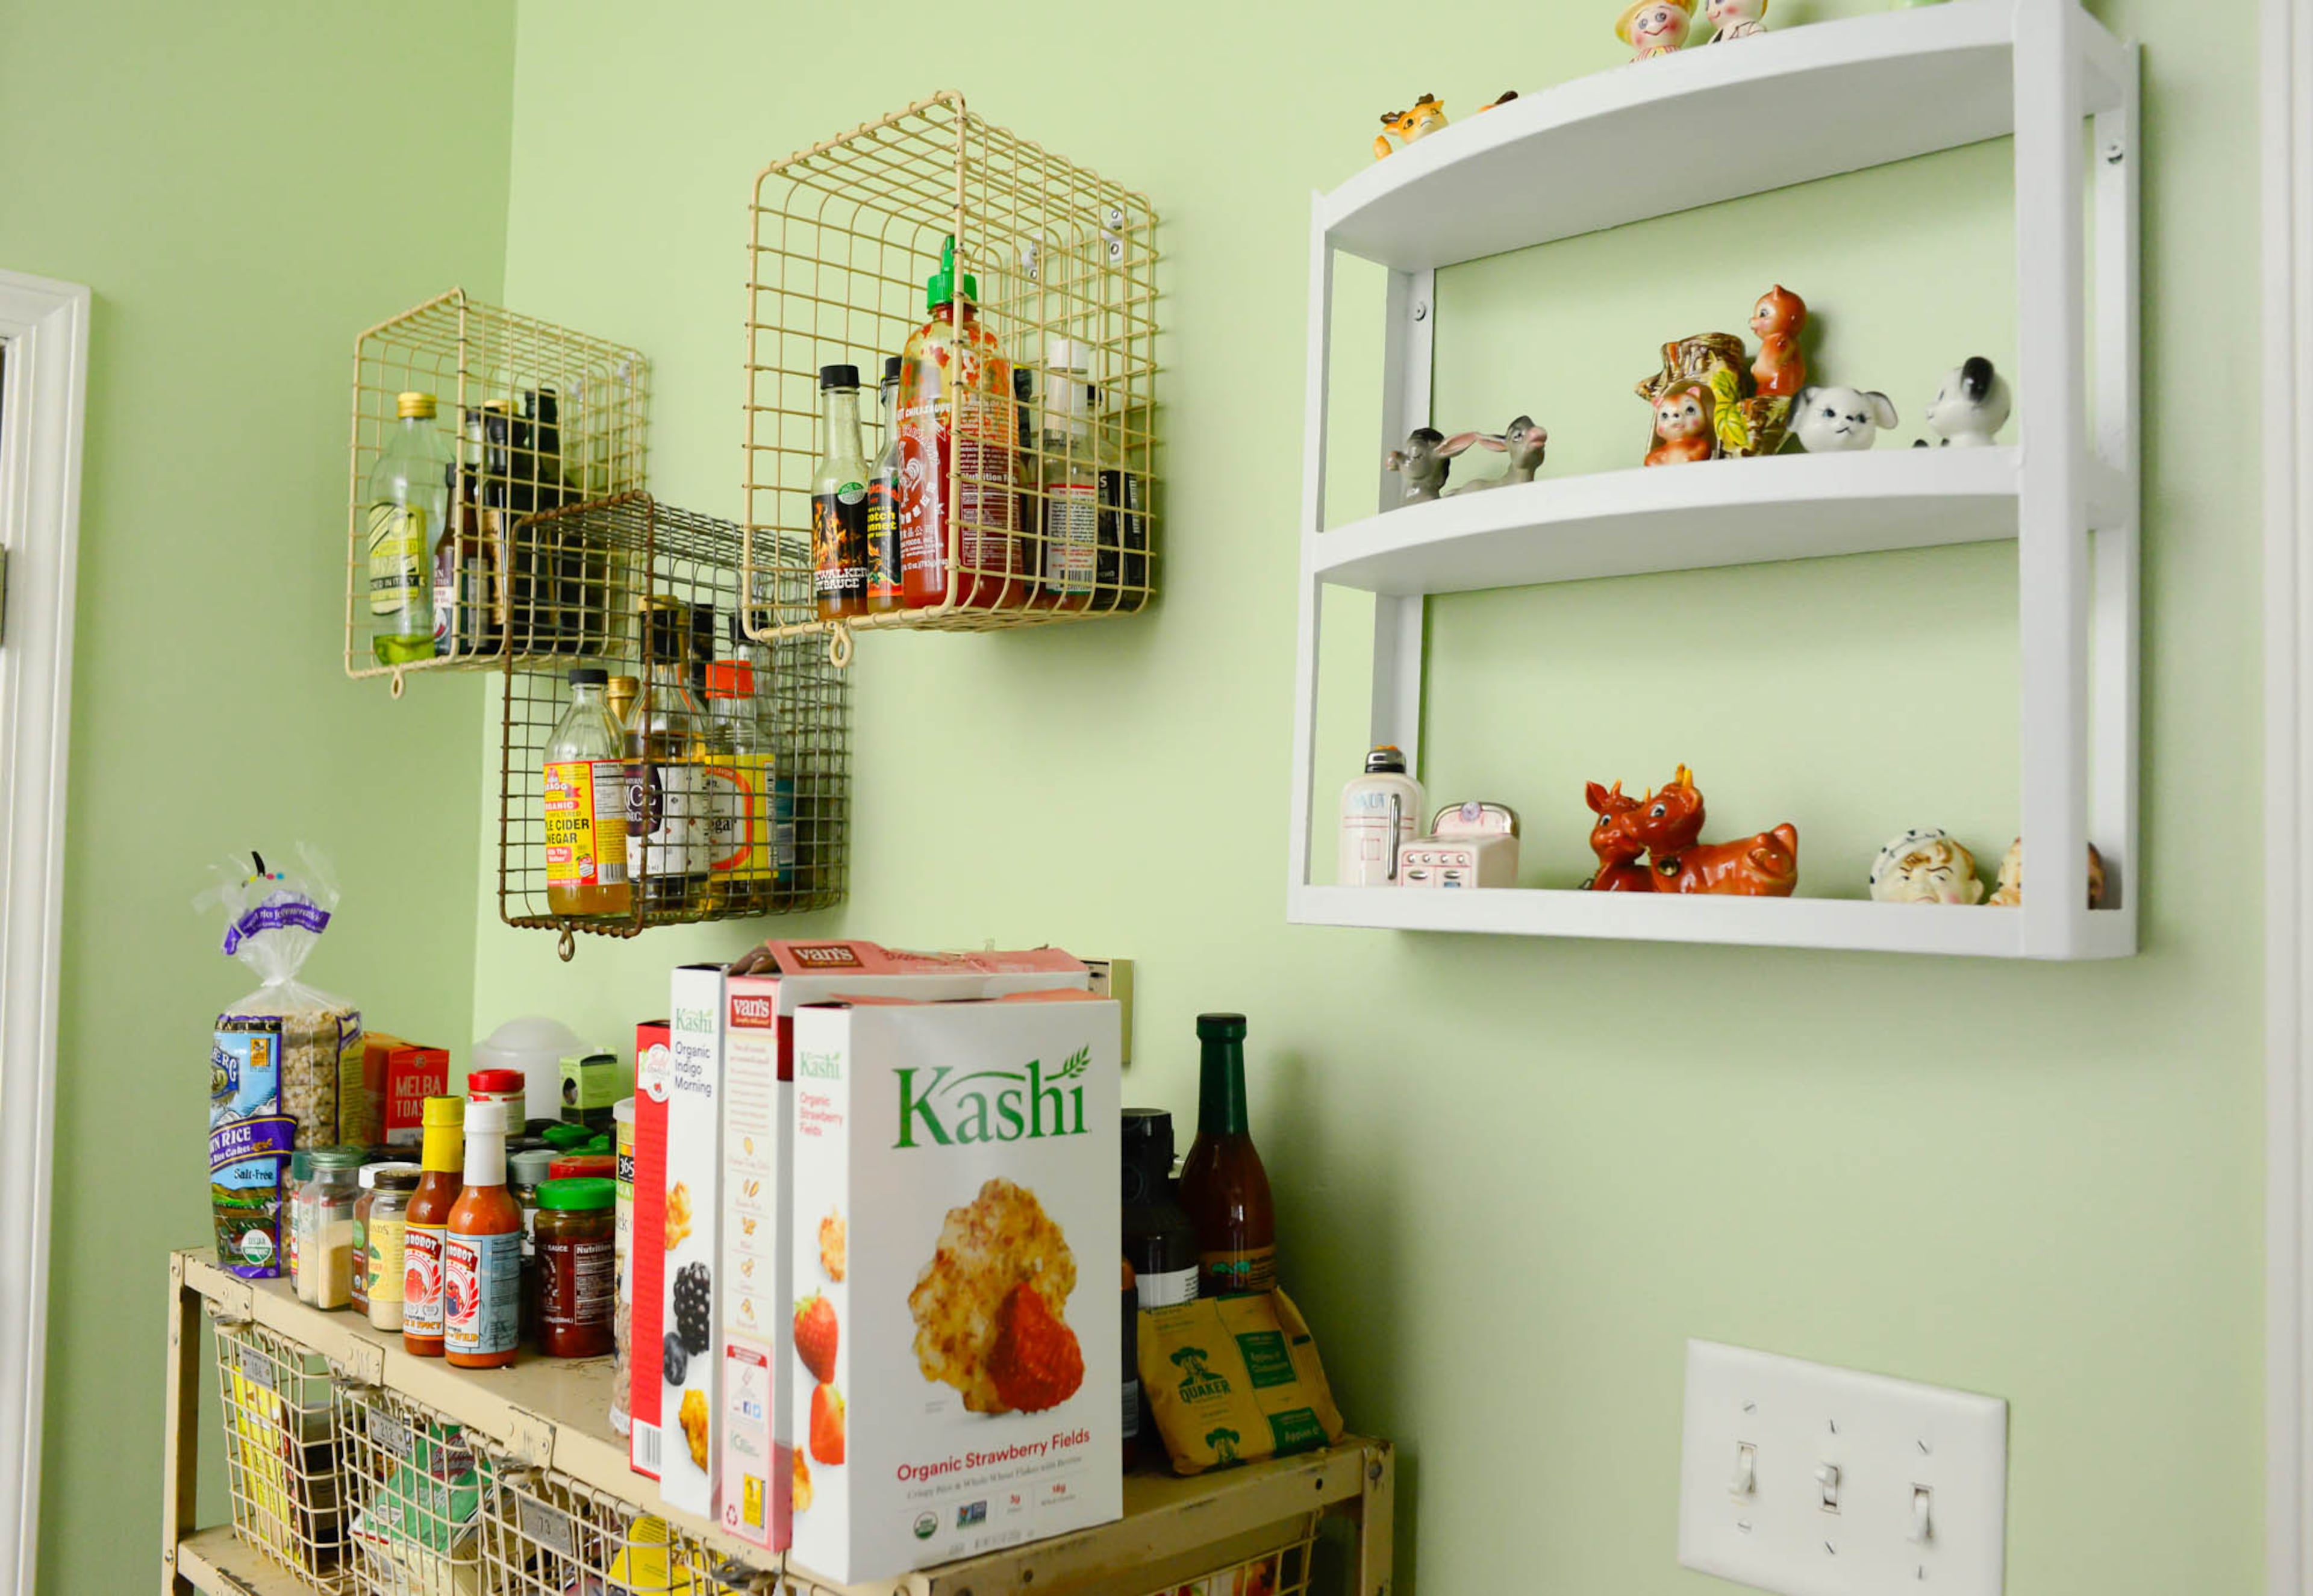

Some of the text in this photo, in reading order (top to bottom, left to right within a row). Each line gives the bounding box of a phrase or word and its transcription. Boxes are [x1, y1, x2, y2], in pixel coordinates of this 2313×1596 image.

[963, 472, 1002, 481] Nutition
[556, 818, 590, 831] CIDER
[795, 947, 854, 961] van's
[733, 999, 770, 1018] van's
[676, 1008, 714, 1034] Kashi
[675, 1041, 710, 1059] Organic
[675, 1059, 702, 1076] Indigo
[799, 1052, 842, 1080] Kashi
[395, 1074, 442, 1098] MELBA
[674, 1076, 712, 1097] Morning
[799, 1091, 831, 1108] Organic
[891, 1048, 1091, 1149] Kashi
[396, 1100, 424, 1118] TOAS
[799, 1107, 843, 1126] Strawberry
[221, 1126, 251, 1147] RICE
[799, 1123, 823, 1137] Fields
[234, 1168, 273, 1180] Salt-Free
[619, 1158, 635, 1177] 365
[548, 1244, 569, 1252] SAUCE
[1179, 1380, 1231, 1404] QUAKER
[897, 1428, 1090, 1483] Organic Strawberry Fields
